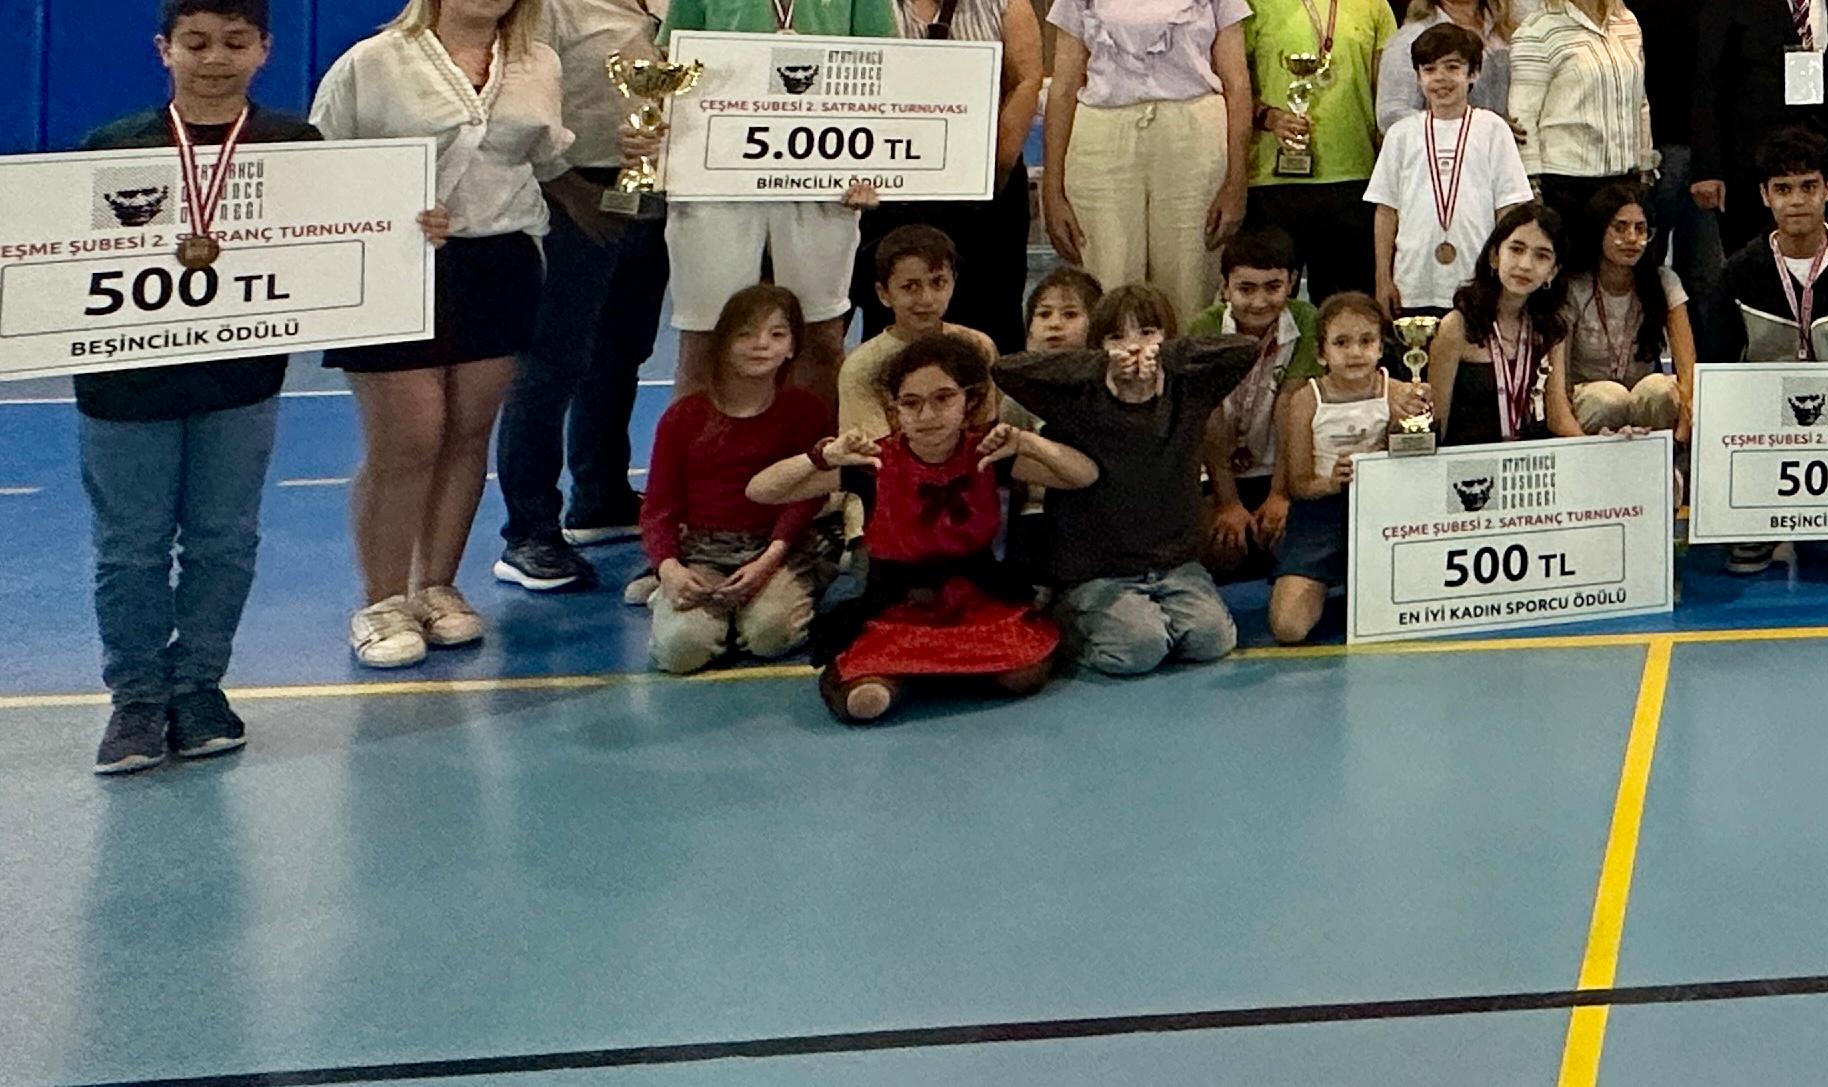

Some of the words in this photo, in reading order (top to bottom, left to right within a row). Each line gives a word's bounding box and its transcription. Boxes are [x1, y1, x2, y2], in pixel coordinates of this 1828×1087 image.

[700, 99, 749, 113] ÇEŞME
[752, 99, 802, 113] ŞUBESİ
[806, 102, 816, 112] 2.
[821, 102, 887, 115] SATRANÇ
[891, 103, 968, 114] TURNUVASI
[742, 125, 874, 160] 5.000
[884, 138, 921, 160] TL
[756, 174, 843, 190] BİRİNCİLİK
[848, 174, 904, 189] ÖDÜLÜ
[180, 199, 264, 223] DNEĞİ
[1, 241, 62, 261] EŞME
[68, 233, 145, 255] ŞUBESİ
[152, 234, 169, 248] 2.
[175, 226, 273, 246] SRANÇ
[278, 220, 391, 239] TURNUVASI
[83, 266, 218, 316] 500
[233, 273, 290, 303] TL
[70, 327, 209, 358] BEŞİNCİLİK
[217, 318, 299, 343] ÖDÜLÜ
[1722, 434, 1764, 447] ÇEŞME
[1768, 431, 1813, 447] ŞUBESİ
[1816, 433, 1825, 443] 2.
[1382, 525, 1429, 541] ÇEŞME
[1433, 517, 1481, 536] ŞUBESİ
[1485, 519, 1495, 529] 2.
[1499, 514, 1562, 528] SATRANÇ
[1567, 507, 1643, 522] TURNUVASI
[1444, 544, 1529, 588] 500
[1538, 553, 1575, 578] TL
[1399, 611, 1420, 625] EN
[1425, 607, 1445, 623] İYİ
[1450, 604, 1500, 621] KADIN
[1506, 598, 1568, 614] SPORCU
[1573, 588, 1626, 607] ÖDÜLÜ
